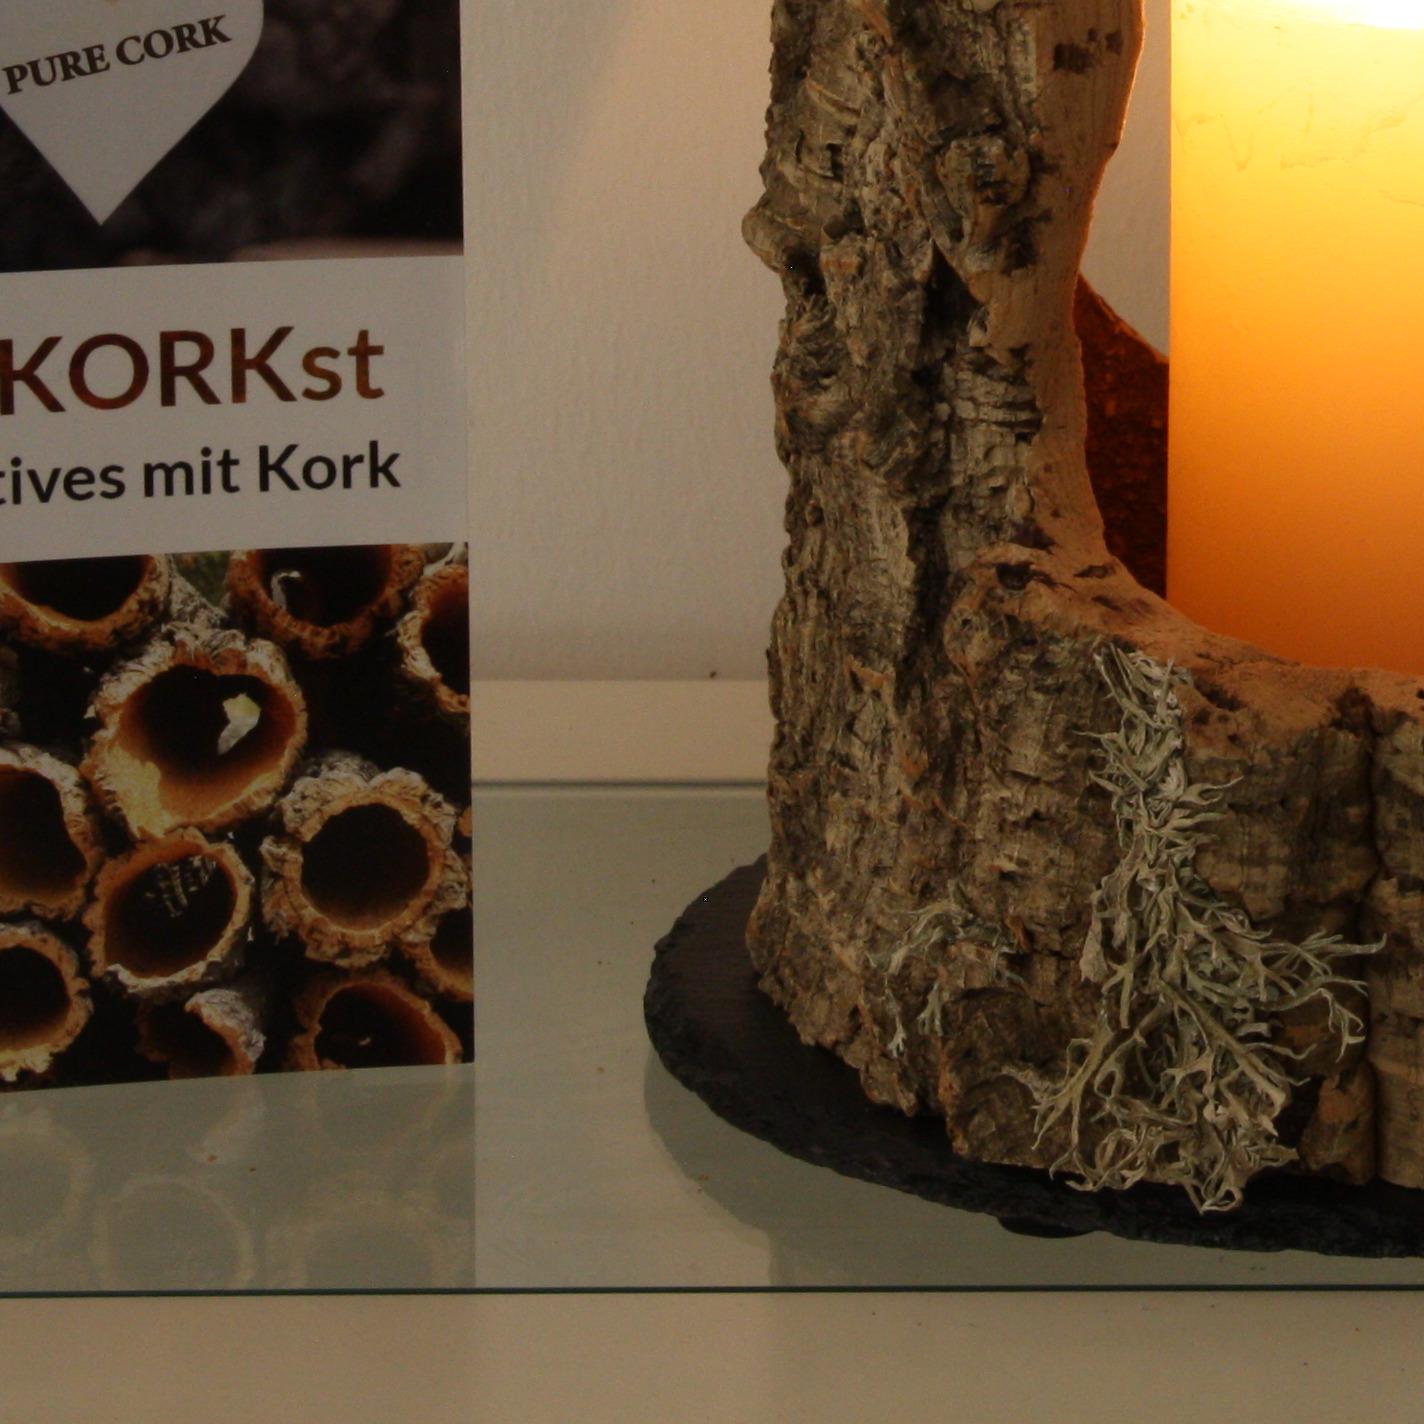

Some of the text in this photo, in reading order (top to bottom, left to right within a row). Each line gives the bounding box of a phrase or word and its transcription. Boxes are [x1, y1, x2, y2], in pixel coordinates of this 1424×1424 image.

[2, 14, 232, 95] PURE CORK
[0, 326, 385, 415] KORKst
[144, 446, 239, 497] mit
[259, 440, 401, 492] Kork
